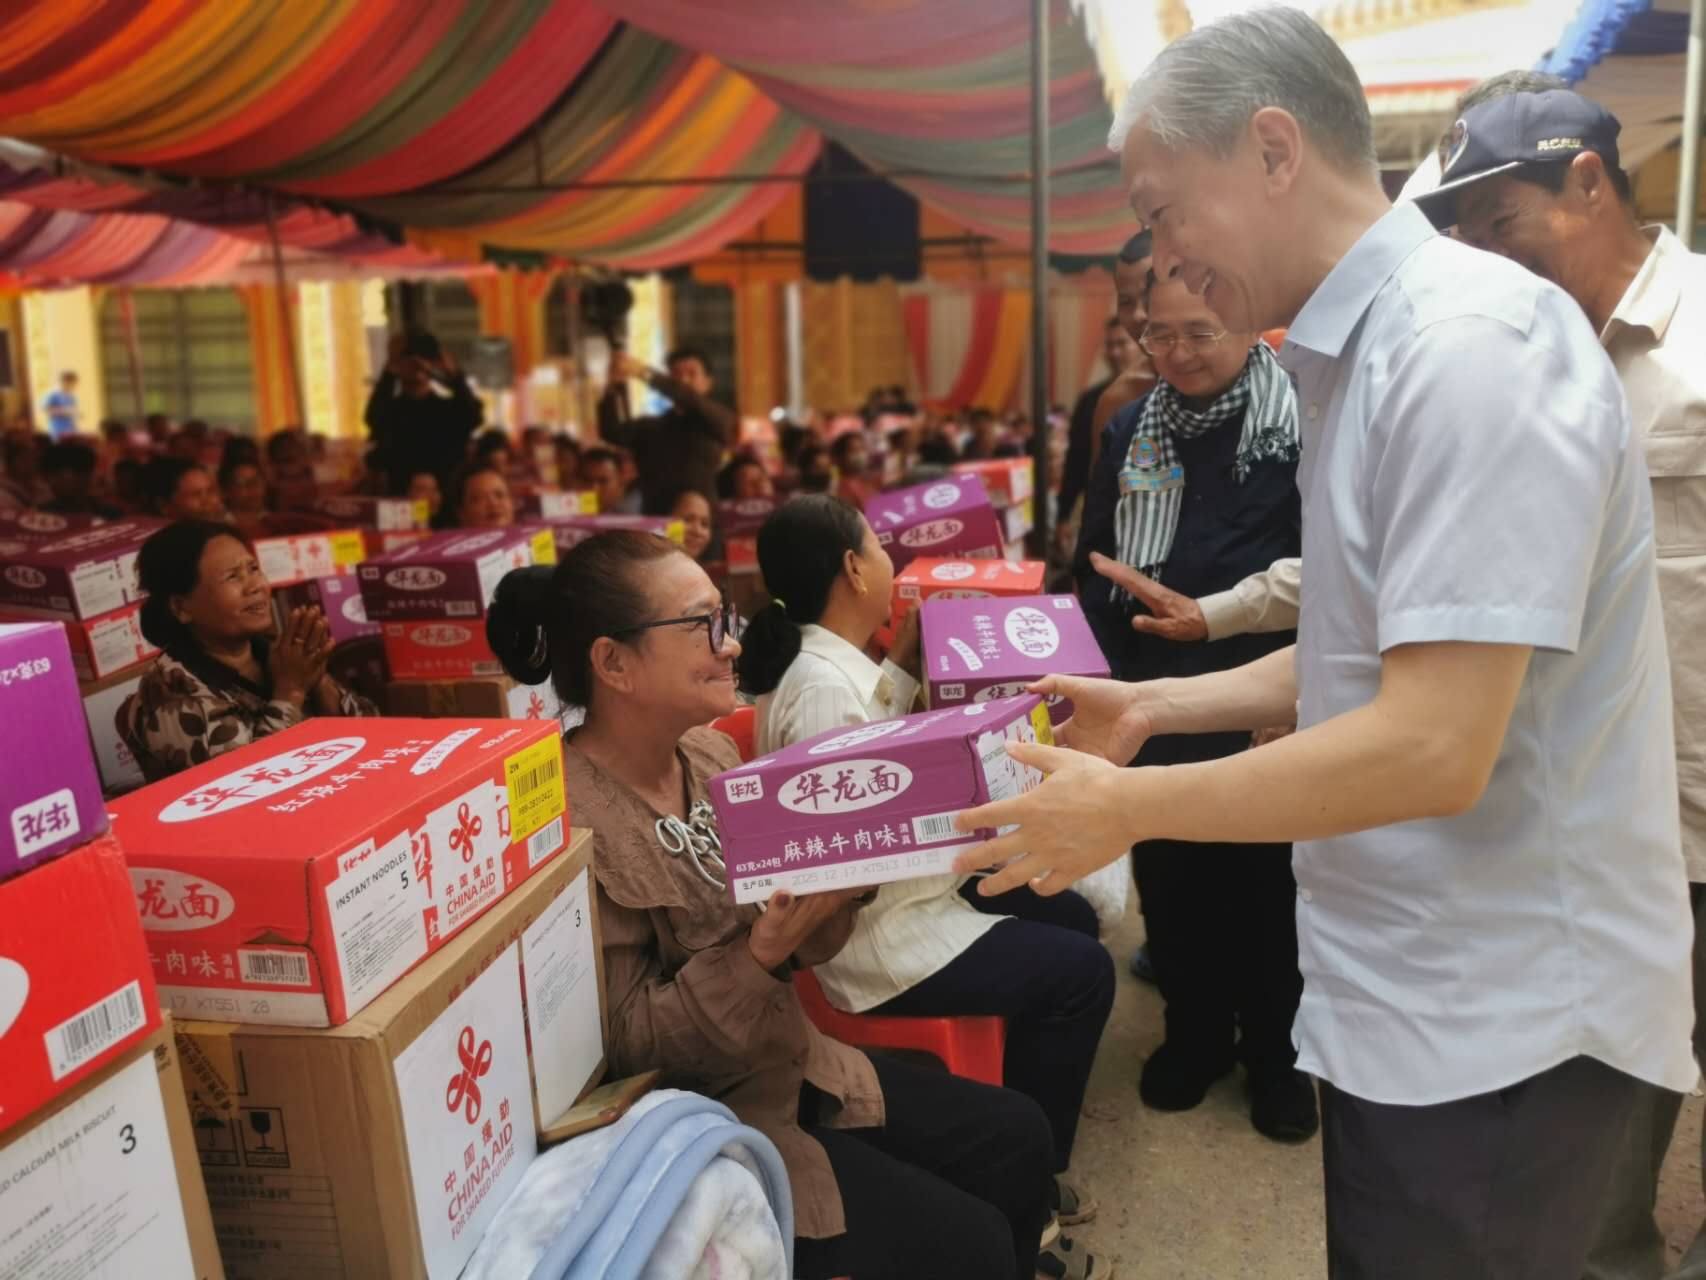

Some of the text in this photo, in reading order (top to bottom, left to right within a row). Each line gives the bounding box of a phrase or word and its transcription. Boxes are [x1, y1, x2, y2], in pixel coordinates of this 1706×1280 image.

[0, 657, 51, 685] 63克x2
[729, 779, 761, 798] 华龙
[792, 765, 900, 810] 华龙面
[19, 802, 71, 844] 华龙
[784, 824, 899, 863] 麻辣牛肉味
[139, 880, 219, 919] 龙面
[336, 877, 371, 910] INSTANT
[372, 850, 408, 882] NOODLES
[400, 870, 409, 890] 5
[447, 884, 479, 914] CHINA
[479, 872, 496, 893] AID
[575, 909, 582, 928] 3
[119, 1123, 137, 1155] 3
[448, 1122, 513, 1221] CHINA AID
[451, 1214, 467, 1240] FOR
